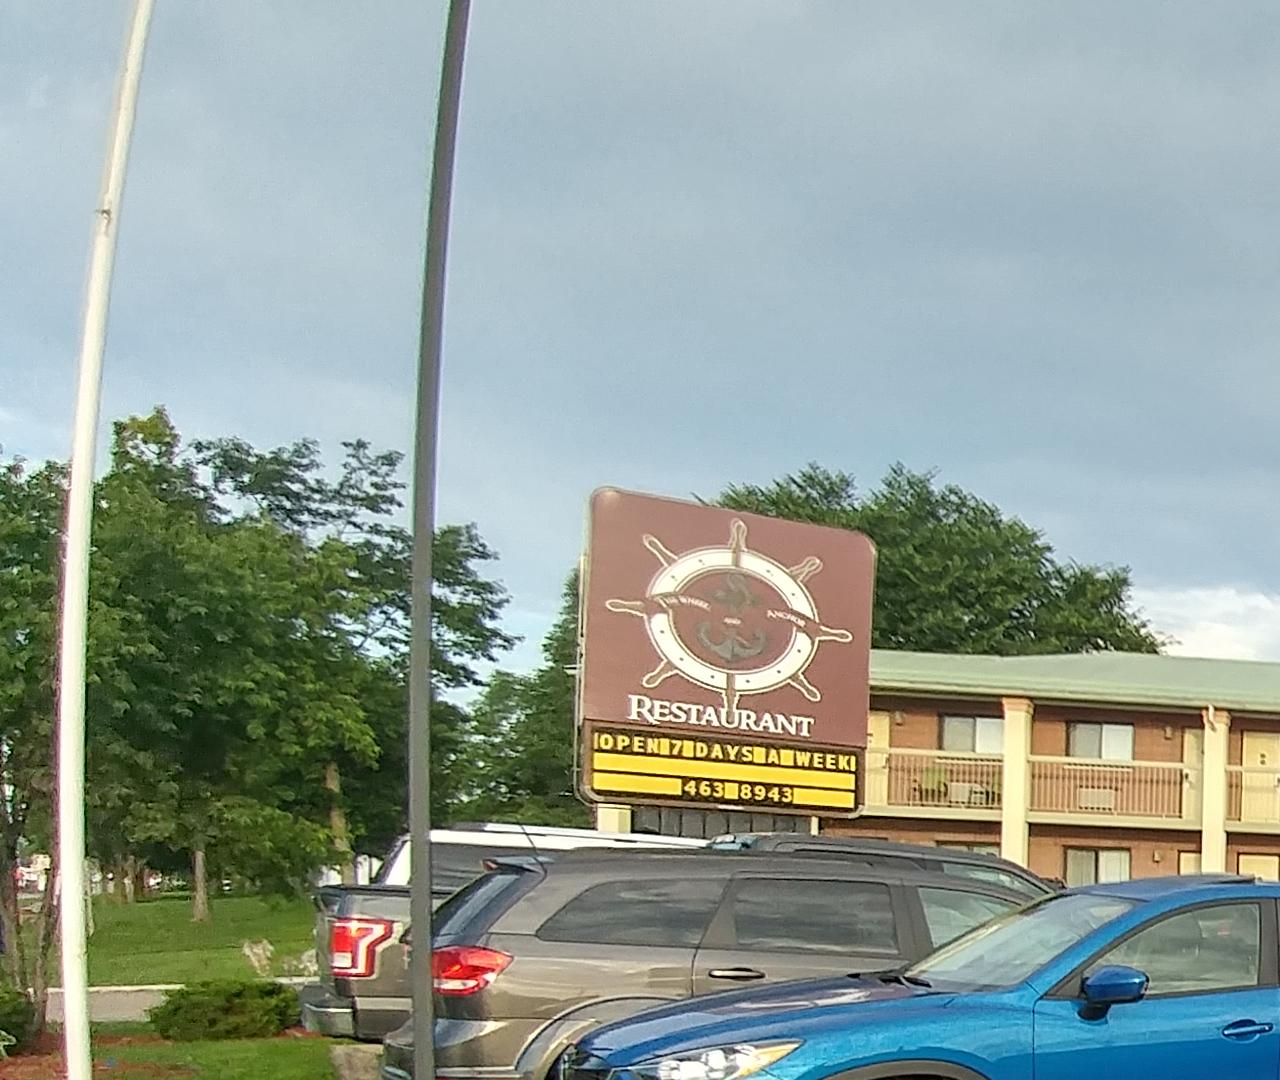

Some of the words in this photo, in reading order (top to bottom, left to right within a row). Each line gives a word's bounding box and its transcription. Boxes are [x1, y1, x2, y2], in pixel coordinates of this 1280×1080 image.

[766, 609, 806, 628] ANCHOR
[627, 694, 815, 737] RESTAURANT
[600, 733, 659, 753] OPEN
[671, 740, 682, 755] 7
[695, 742, 753, 762] DAYS
[767, 749, 779, 765] A
[796, 751, 849, 770] WEEK
[684, 780, 724, 798] 463
[740, 784, 793, 803] 8943
